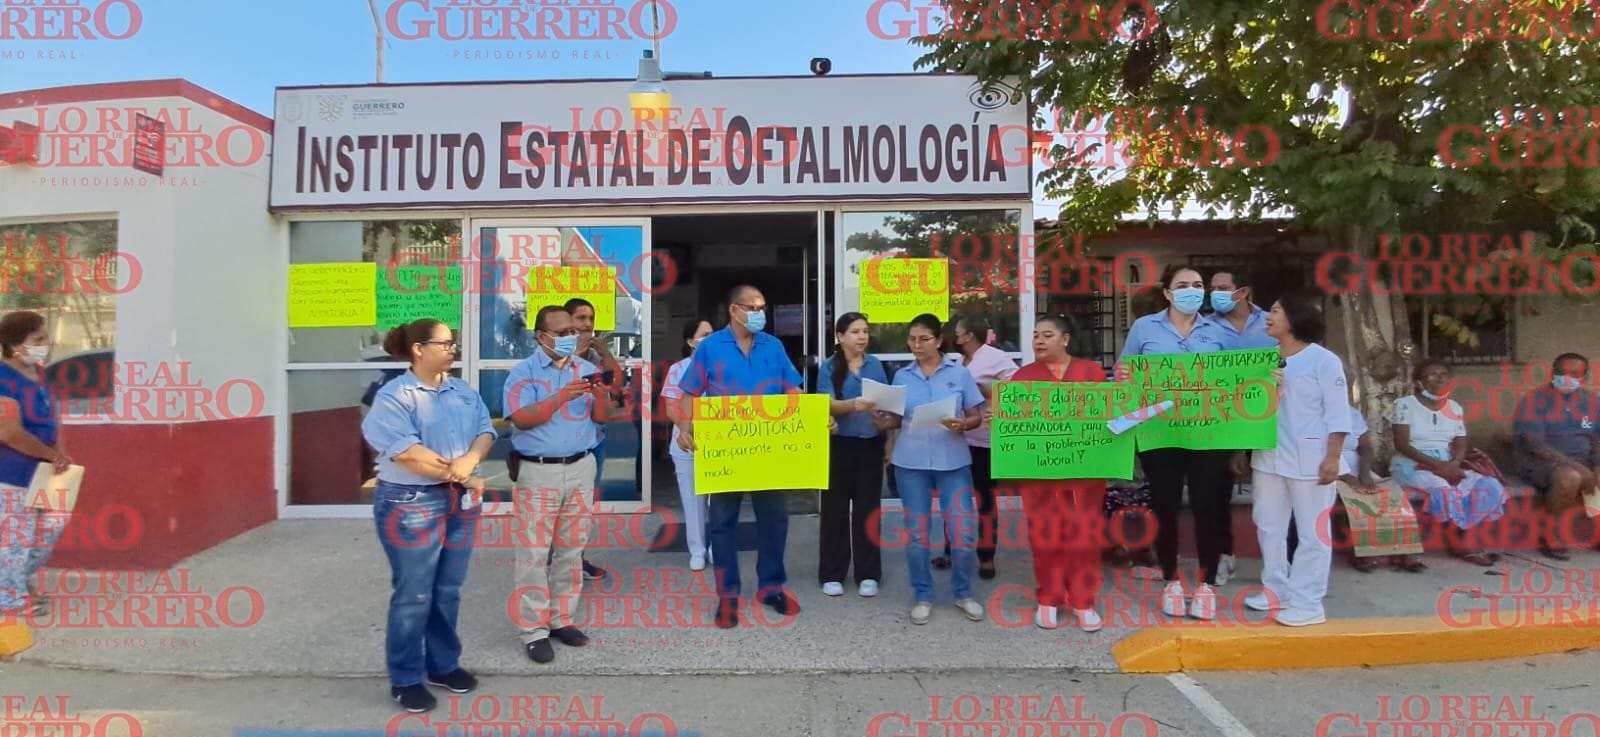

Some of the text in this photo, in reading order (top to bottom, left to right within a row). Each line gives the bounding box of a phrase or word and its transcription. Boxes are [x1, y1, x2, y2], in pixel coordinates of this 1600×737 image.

[352, 102, 404, 110] GUERRERO
[295, 112, 1006, 193] INSTITUTO ESTATAL DE OFTALMOLOGÍA
[1131, 356, 1148, 372] NO
[1160, 357, 1181, 370] AL
[1142, 376, 1152, 390] el
[1215, 377, 1230, 388] es
[1235, 374, 1244, 386] la
[998, 382, 1042, 404] Pedimos
[1116, 390, 1126, 401] la
[1070, 406, 1082, 417] de
[1090, 406, 1100, 416] la
[1174, 397, 1200, 412] para
[998, 422, 1102, 438] GOBERNADORA para
[703, 442, 812, 460] transparente no a
[1000, 442, 1016, 452] ver
[1026, 440, 1036, 451] la
